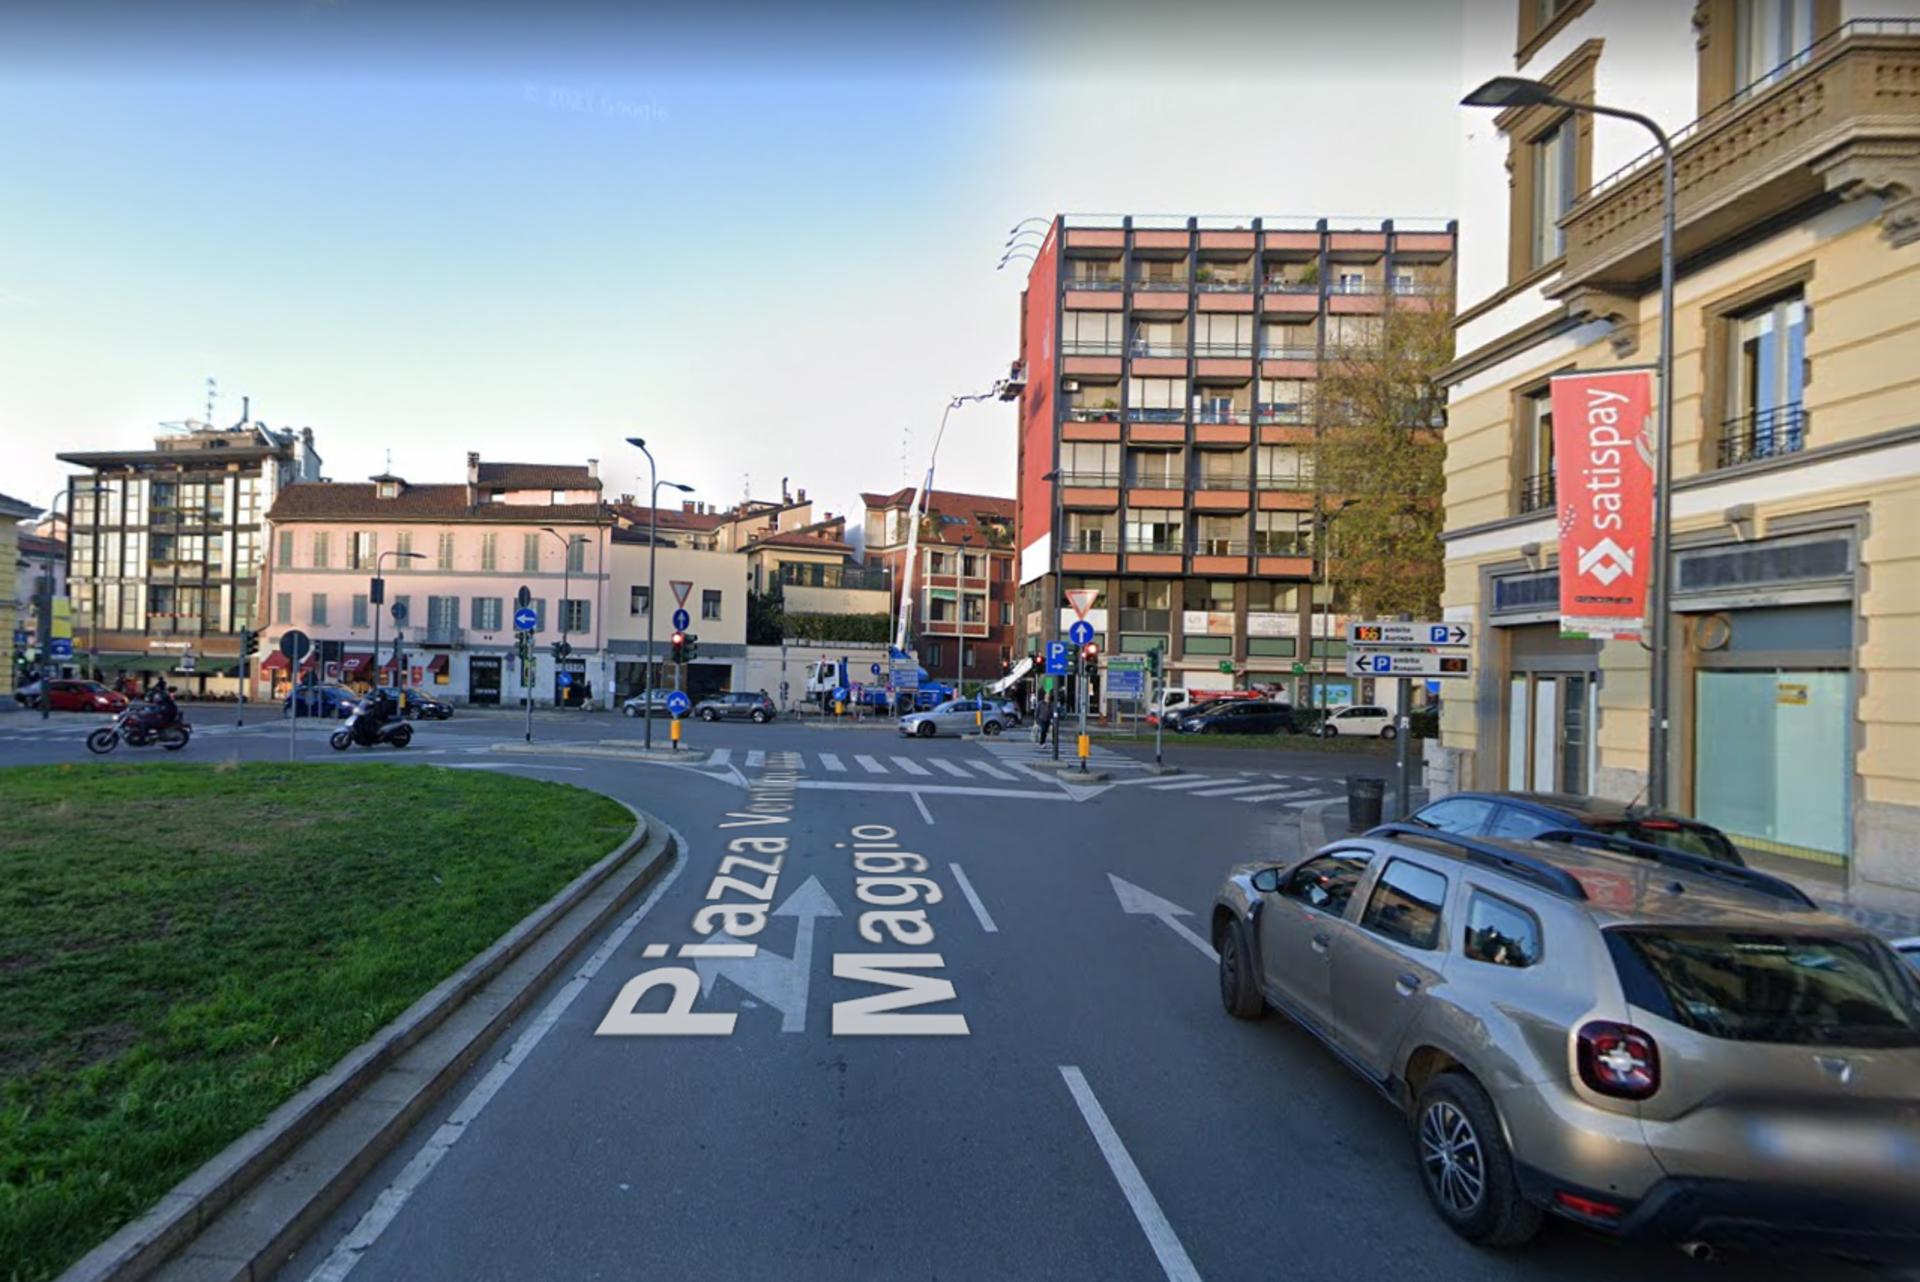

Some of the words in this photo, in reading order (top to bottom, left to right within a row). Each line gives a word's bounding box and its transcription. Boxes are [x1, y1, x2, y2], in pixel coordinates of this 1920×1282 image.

[1582, 388, 1633, 530] satispay
[1434, 629, 1446, 640] P
[1052, 643, 1064, 659] P
[1377, 657, 1388, 670] P
